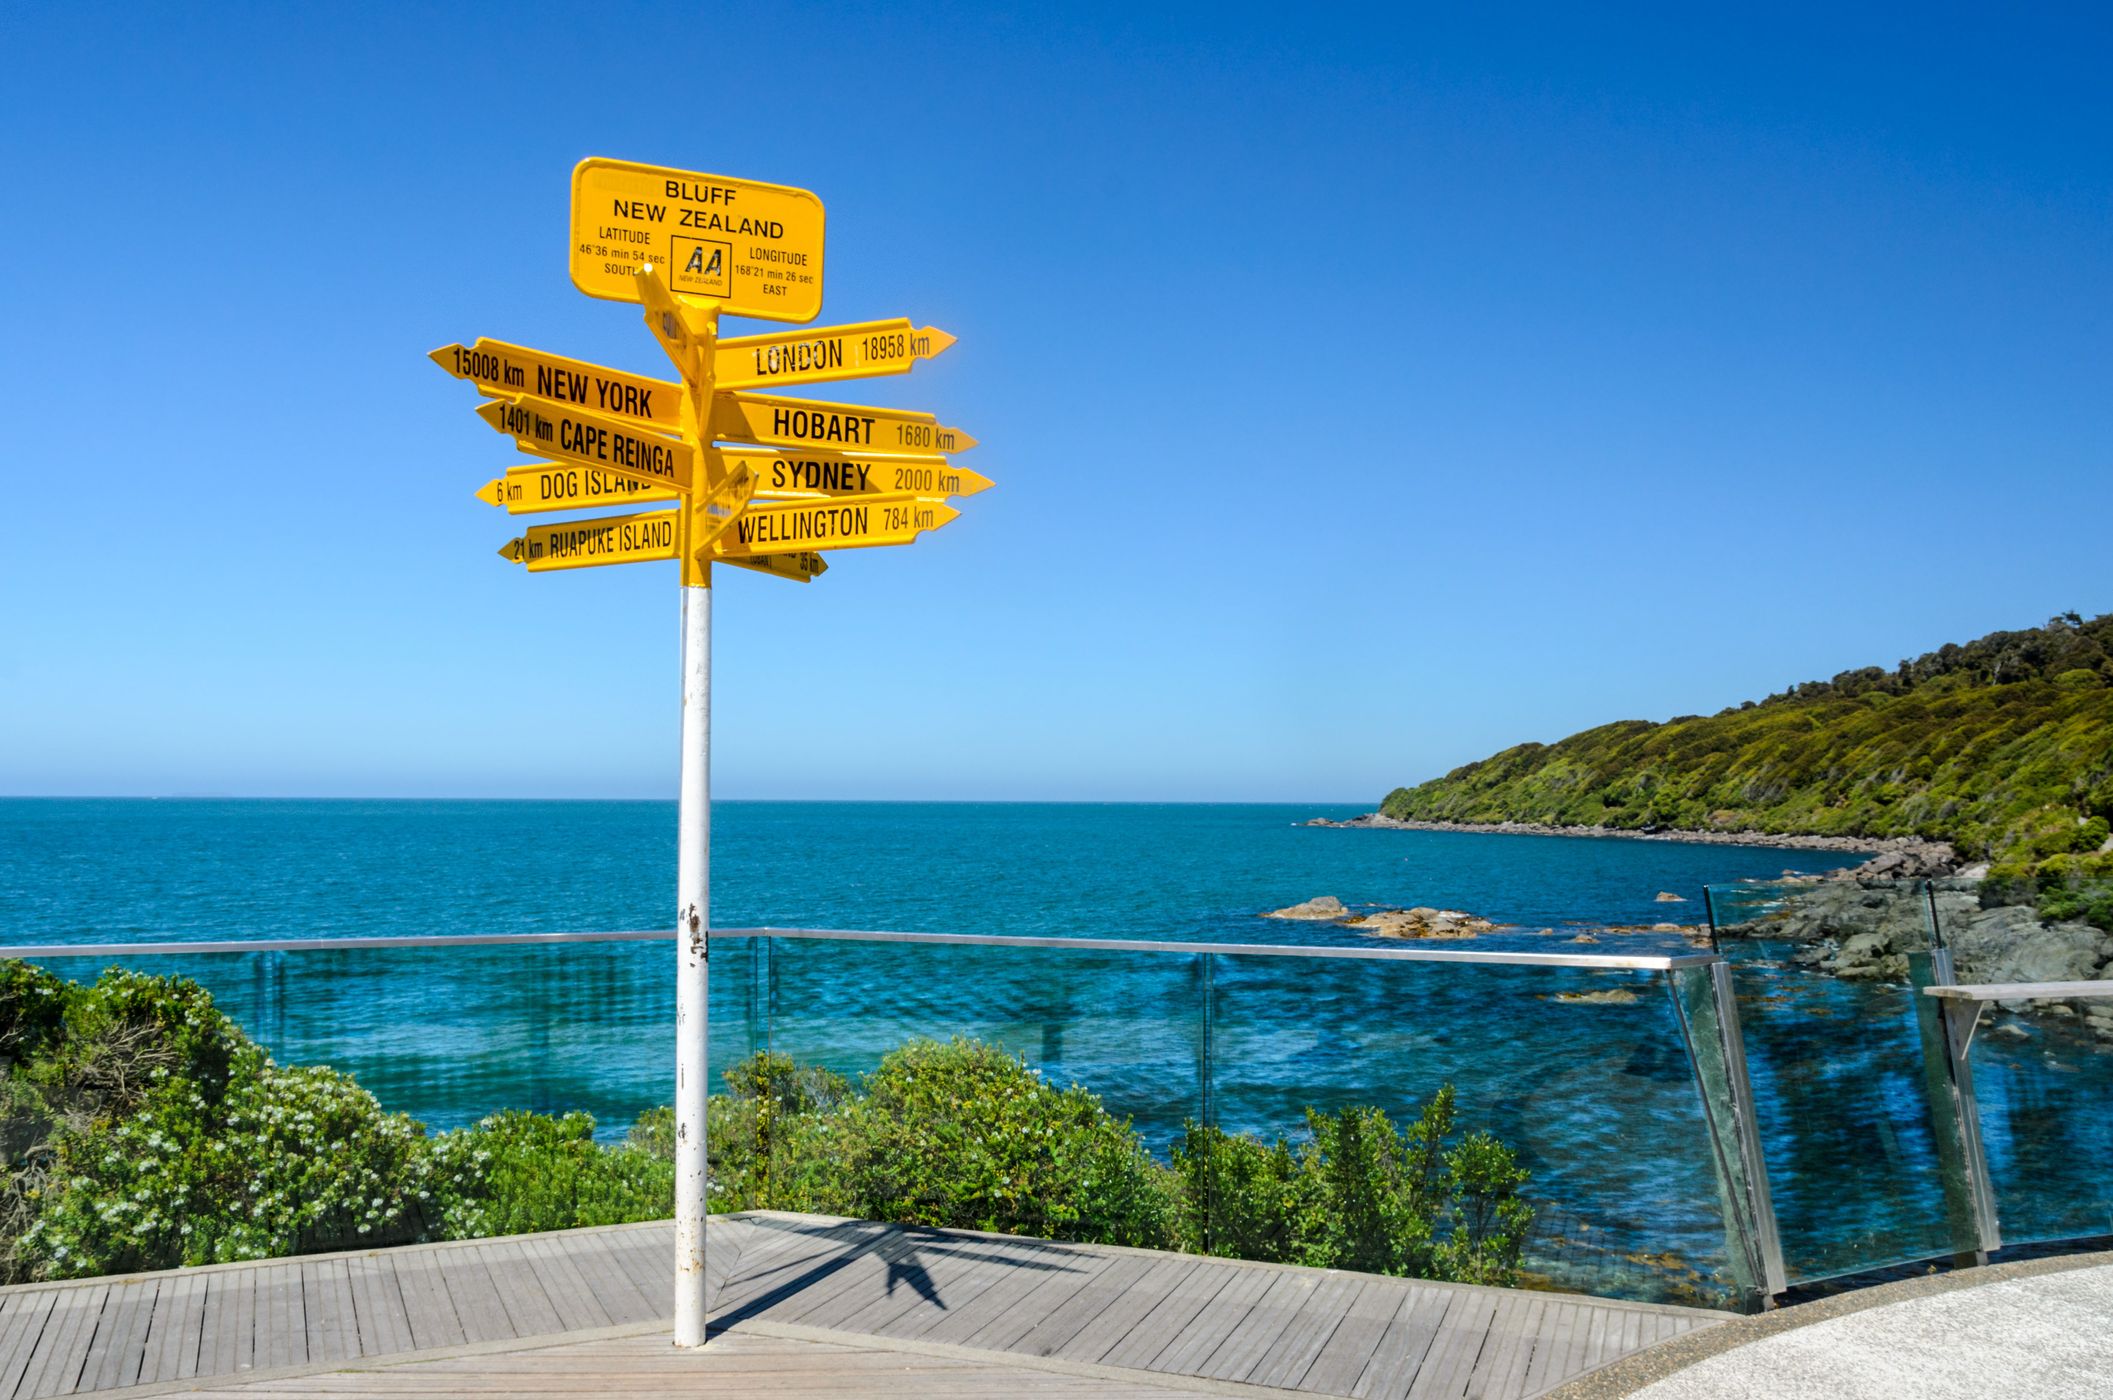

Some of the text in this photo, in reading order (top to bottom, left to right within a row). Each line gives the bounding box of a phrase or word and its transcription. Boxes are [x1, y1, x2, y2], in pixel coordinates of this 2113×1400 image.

[666, 180, 736, 206] BLUFF
[614, 200, 784, 238] NEW ZEALAND
[599, 226, 650, 244] LATITUDE
[612, 249, 629, 259] min
[633, 251, 644, 261] 54
[648, 254, 664, 264] sec
[686, 246, 722, 276] AA
[750, 247, 807, 266] LONGITUDE
[679, 274, 693, 283] NEW
[763, 284, 787, 296] EAST
[768, 269, 783, 279] min
[786, 272, 796, 281] 26
[799, 274, 813, 284] sec
[756, 334, 930, 376] LONDON 18958 km
[453, 347, 652, 418] 15008 km NEW YORK
[500, 404, 674, 477] 1401 km CAPE REINGA
[774, 409, 954, 450] HOBART 1680 km
[497, 482, 503, 502] 6
[507, 481, 522, 501] km
[541, 472, 578, 500] DOG
[772, 460, 960, 492] SYDNEY 2000 km
[738, 506, 934, 544] WELLINGTON 784 km
[514, 522, 672, 560] 21 km RUAPUKE ISLAND
[810, 553, 818, 573] km
